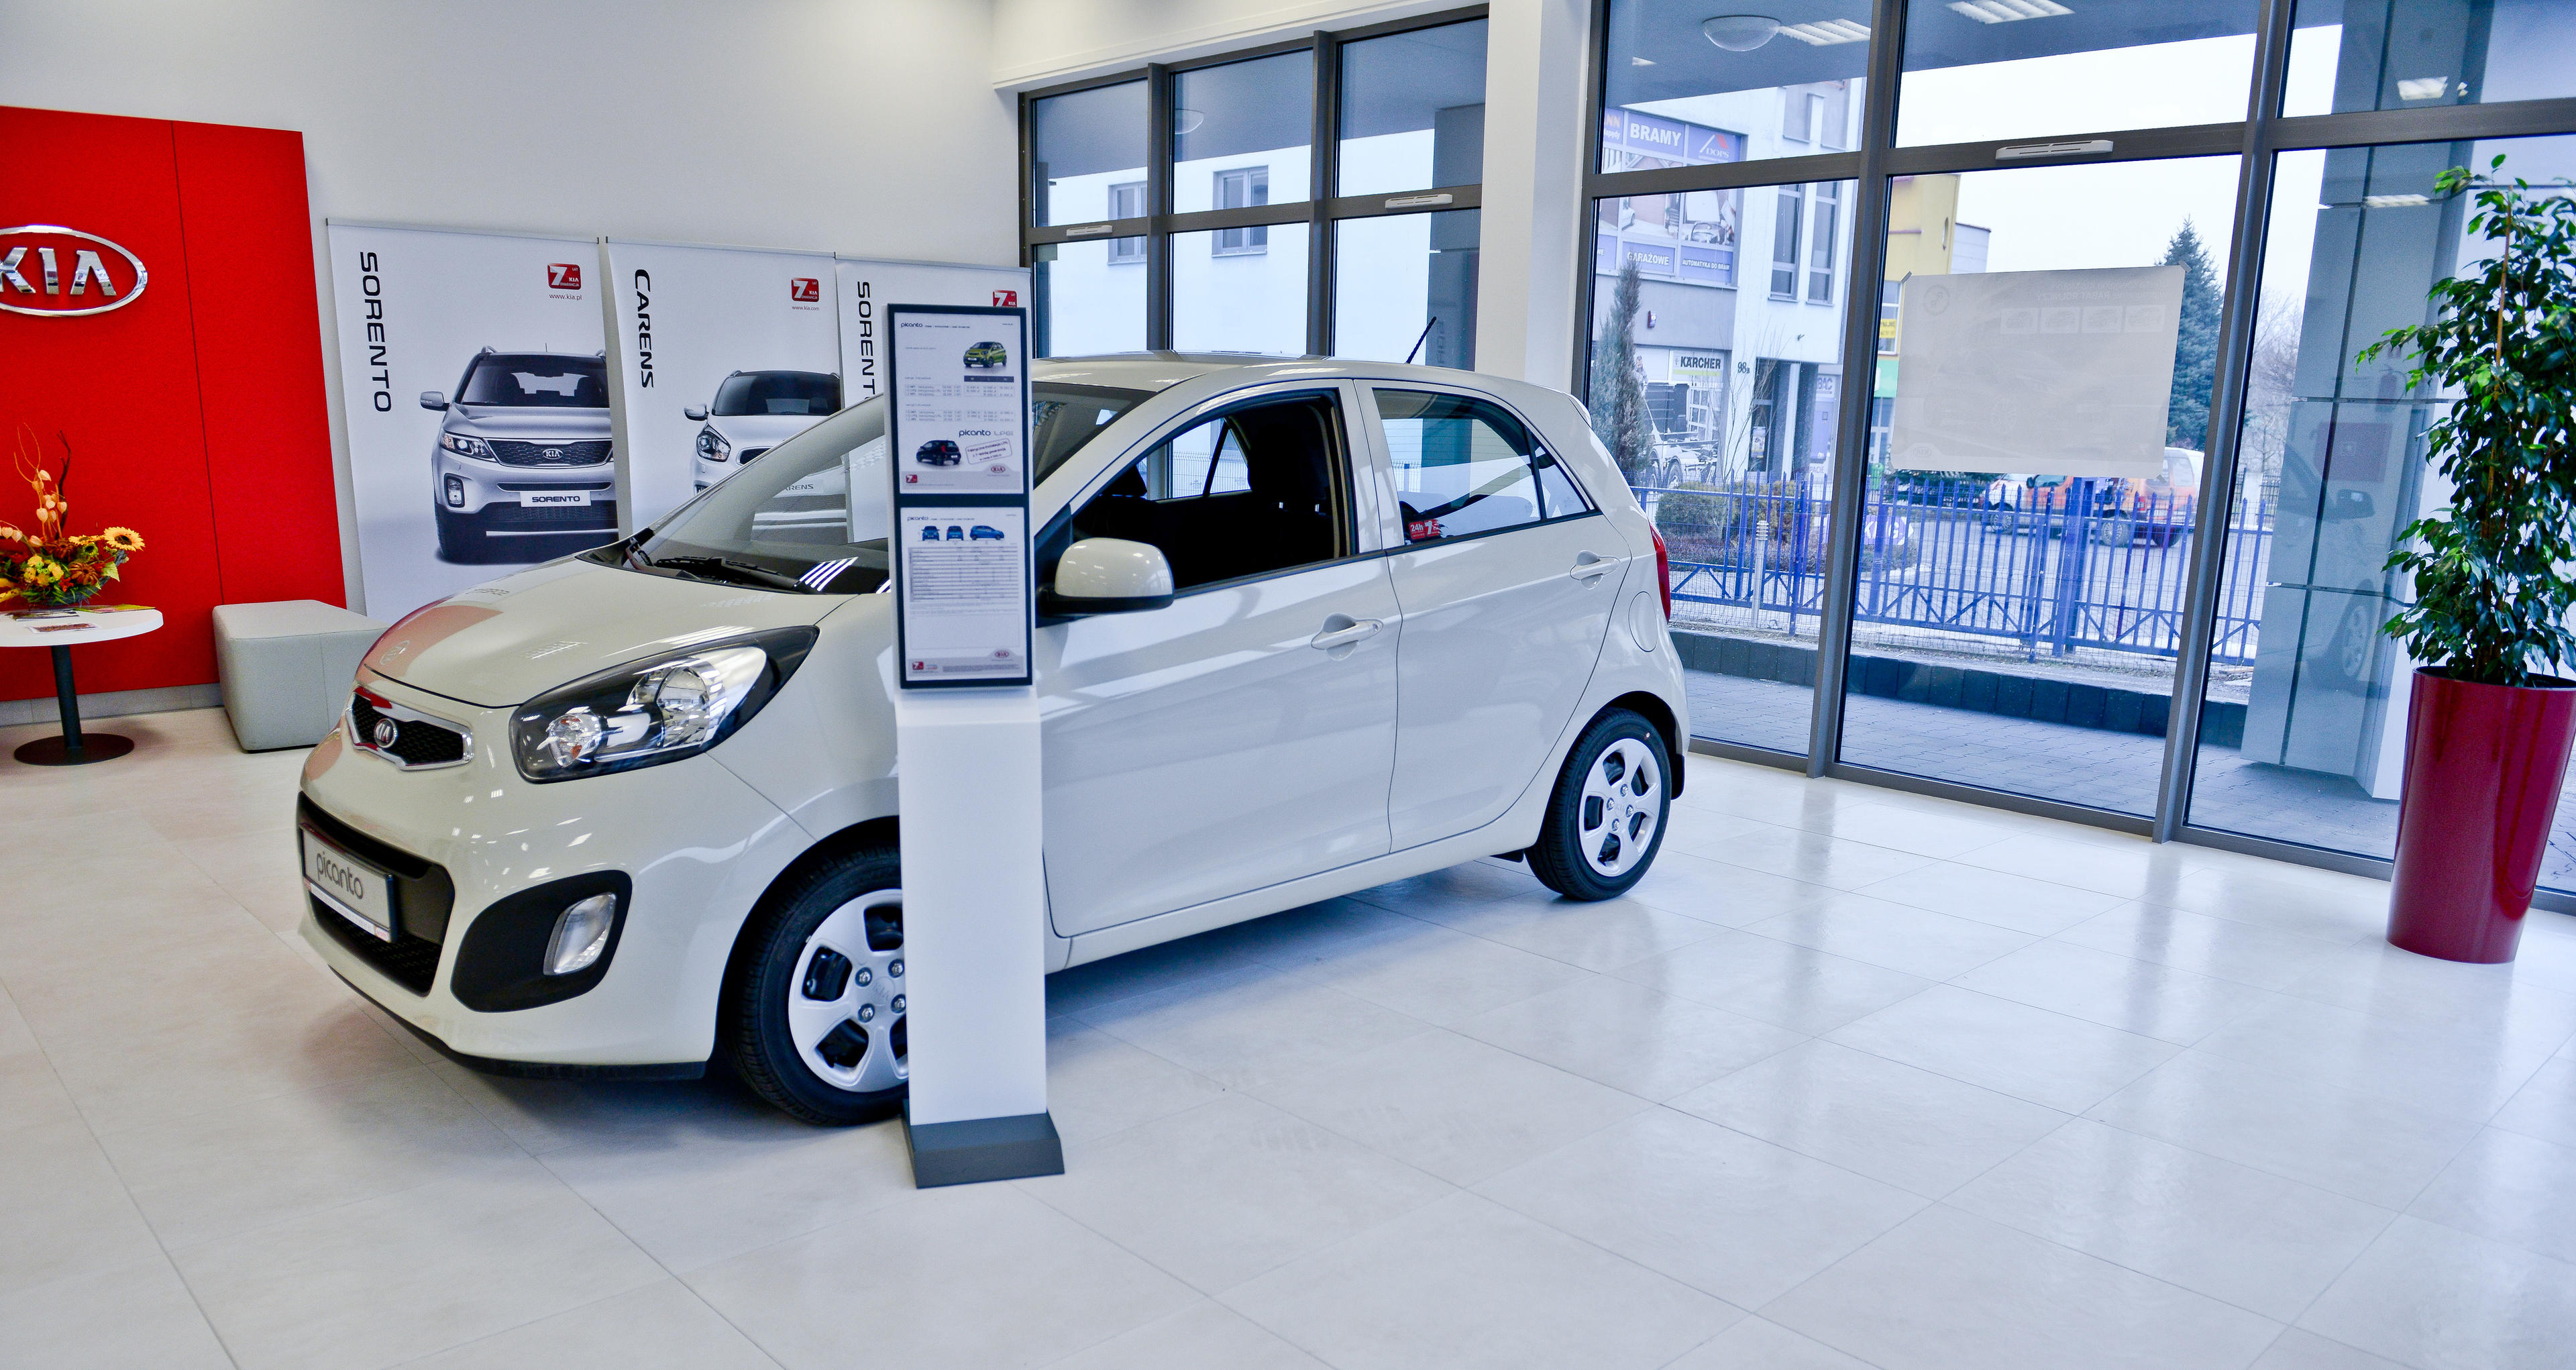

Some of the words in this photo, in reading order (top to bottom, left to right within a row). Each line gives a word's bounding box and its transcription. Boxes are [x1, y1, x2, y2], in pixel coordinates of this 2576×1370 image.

[1630, 123, 1682, 146] BRAMY
[1706, 147, 1729, 158] DOPS
[1627, 252, 1670, 266] GARAŻOWE
[1682, 258, 1711, 268] AUTOMATYKA
[0, 247, 117, 296] KIA
[550, 266, 568, 285] 7
[794, 280, 808, 299] 7
[360, 252, 391, 412] SORENTO
[635, 269, 654, 388] CARENS
[857, 281, 875, 400] SORENT
[1680, 356, 1721, 370] KÄRCHER
[959, 429, 991, 437] picanto
[1410, 523, 1424, 531] 24h
[316, 851, 364, 900] picanto
